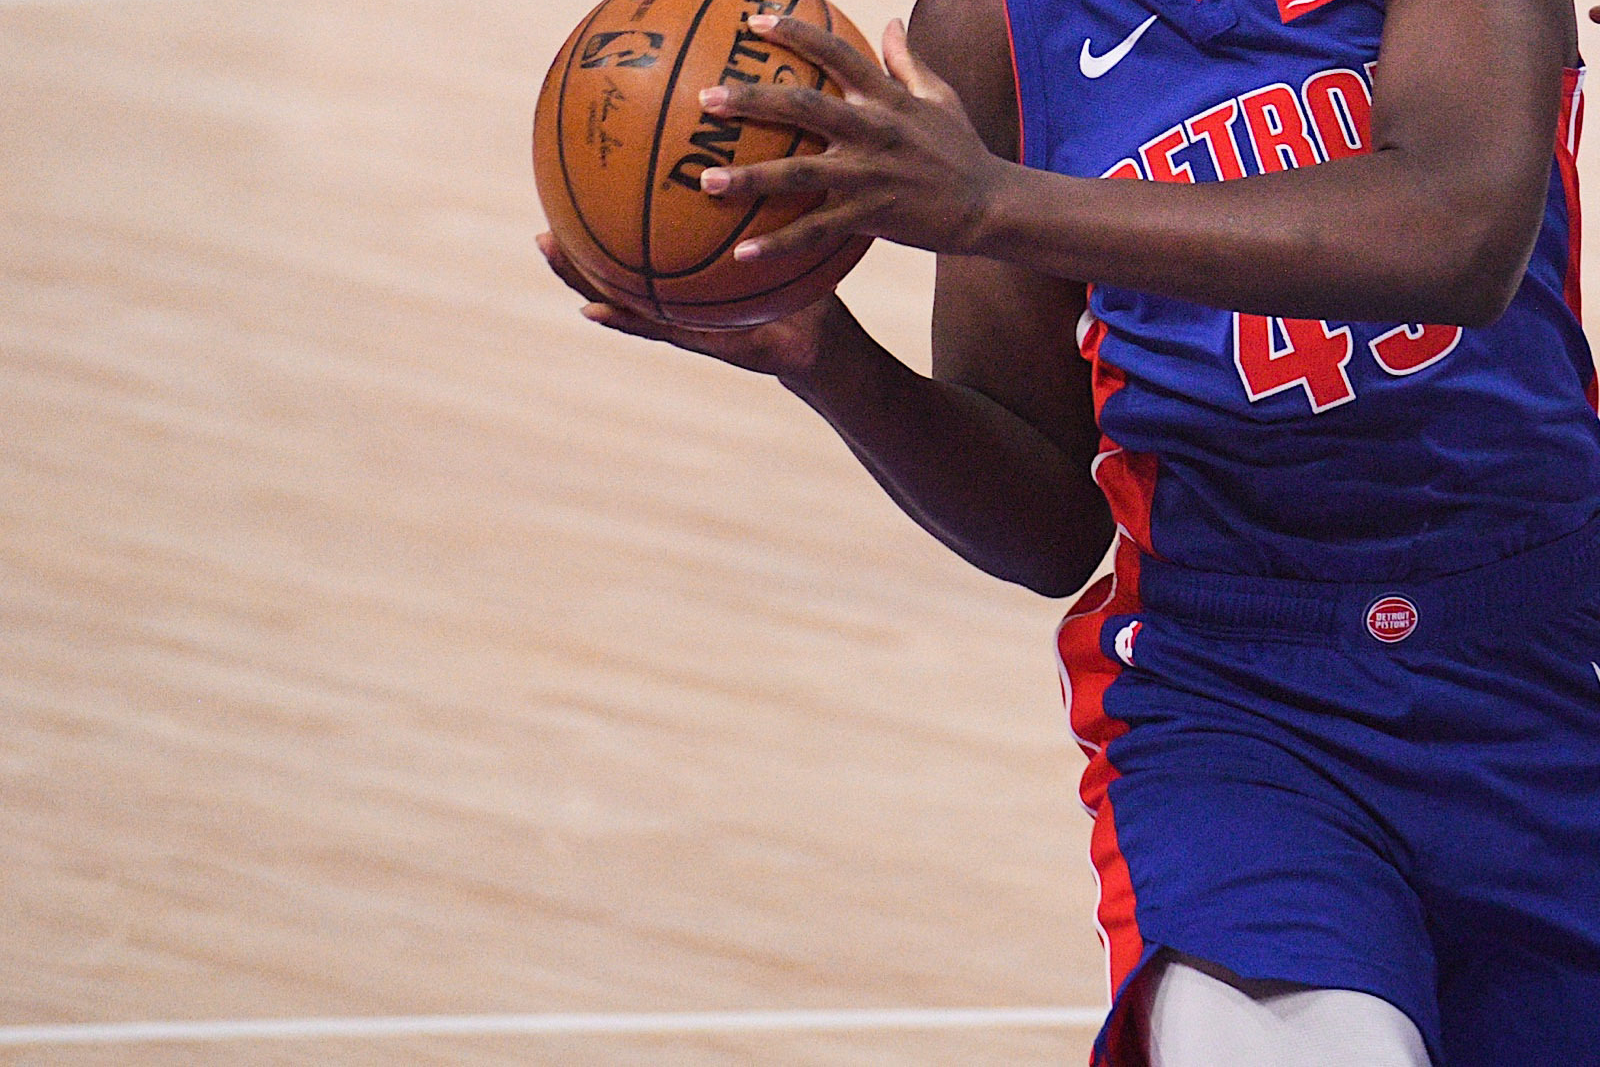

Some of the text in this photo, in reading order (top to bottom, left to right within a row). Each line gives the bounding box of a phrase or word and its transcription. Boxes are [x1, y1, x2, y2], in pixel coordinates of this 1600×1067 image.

[1100, 61, 1378, 183] ETRO
[1375, 611, 1410, 621] DETROIT
[1375, 620, 1410, 629] PISTONS
